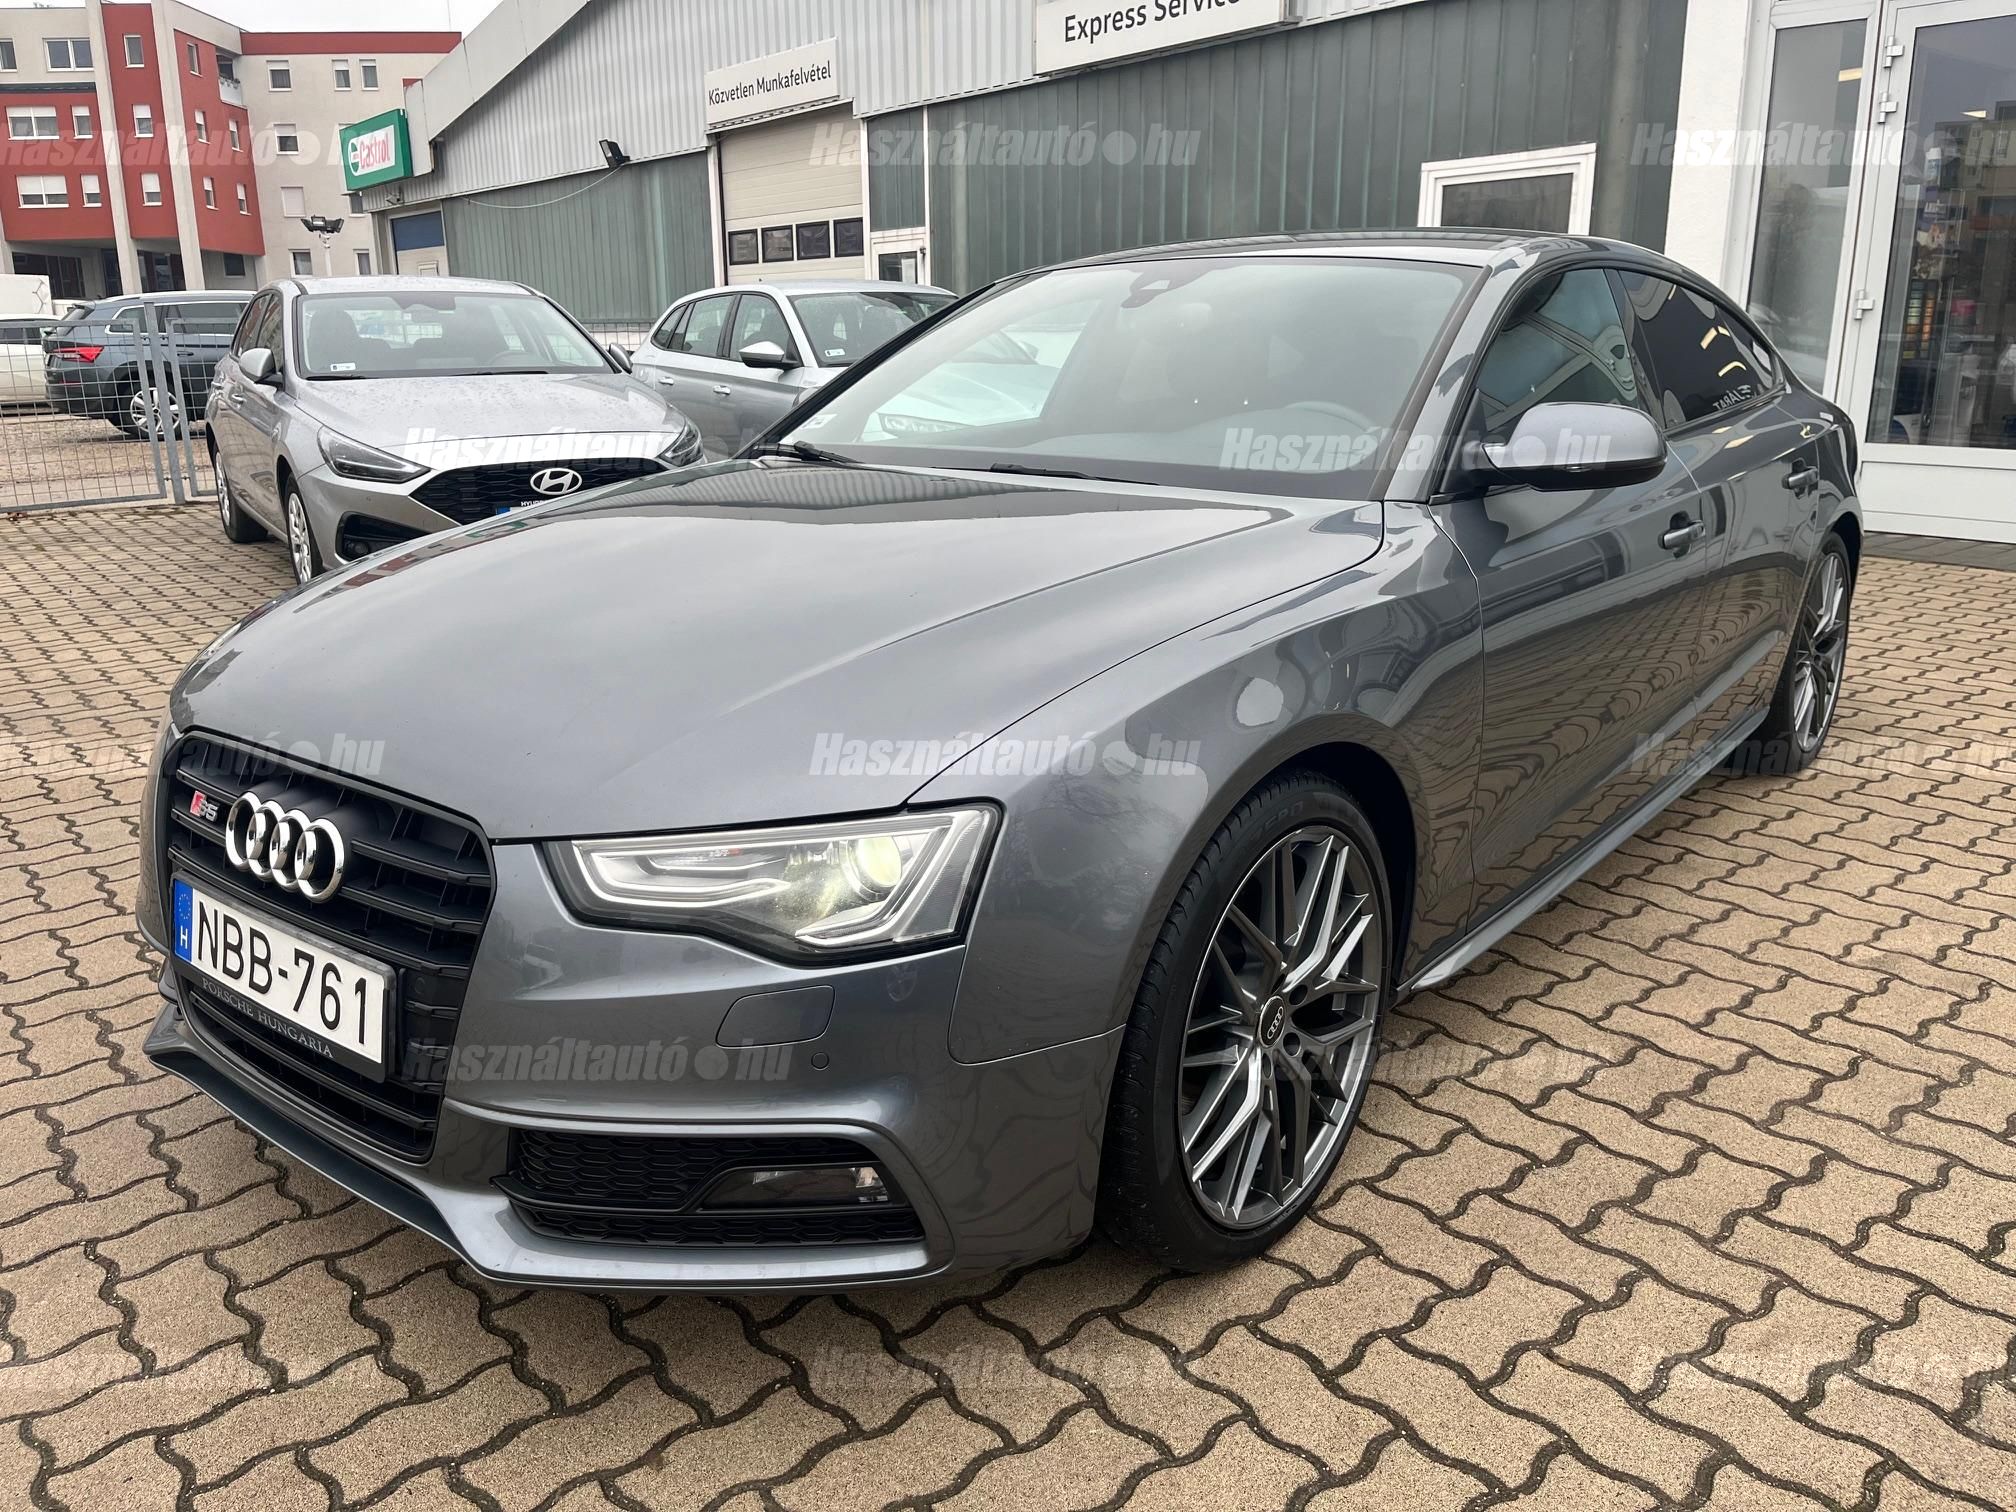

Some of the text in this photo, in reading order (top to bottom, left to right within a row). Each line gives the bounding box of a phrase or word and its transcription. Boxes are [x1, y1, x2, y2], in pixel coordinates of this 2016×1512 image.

[1064, 4, 1147, 44] Express
[708, 60, 831, 106] Közvetlen Munkafelvétel
[360, 133, 391, 169] Castrol
[180, 925, 188, 950] H
[198, 901, 367, 1046] NBB-761
[202, 978, 335, 1059] PORSCHE HUNGARIA
